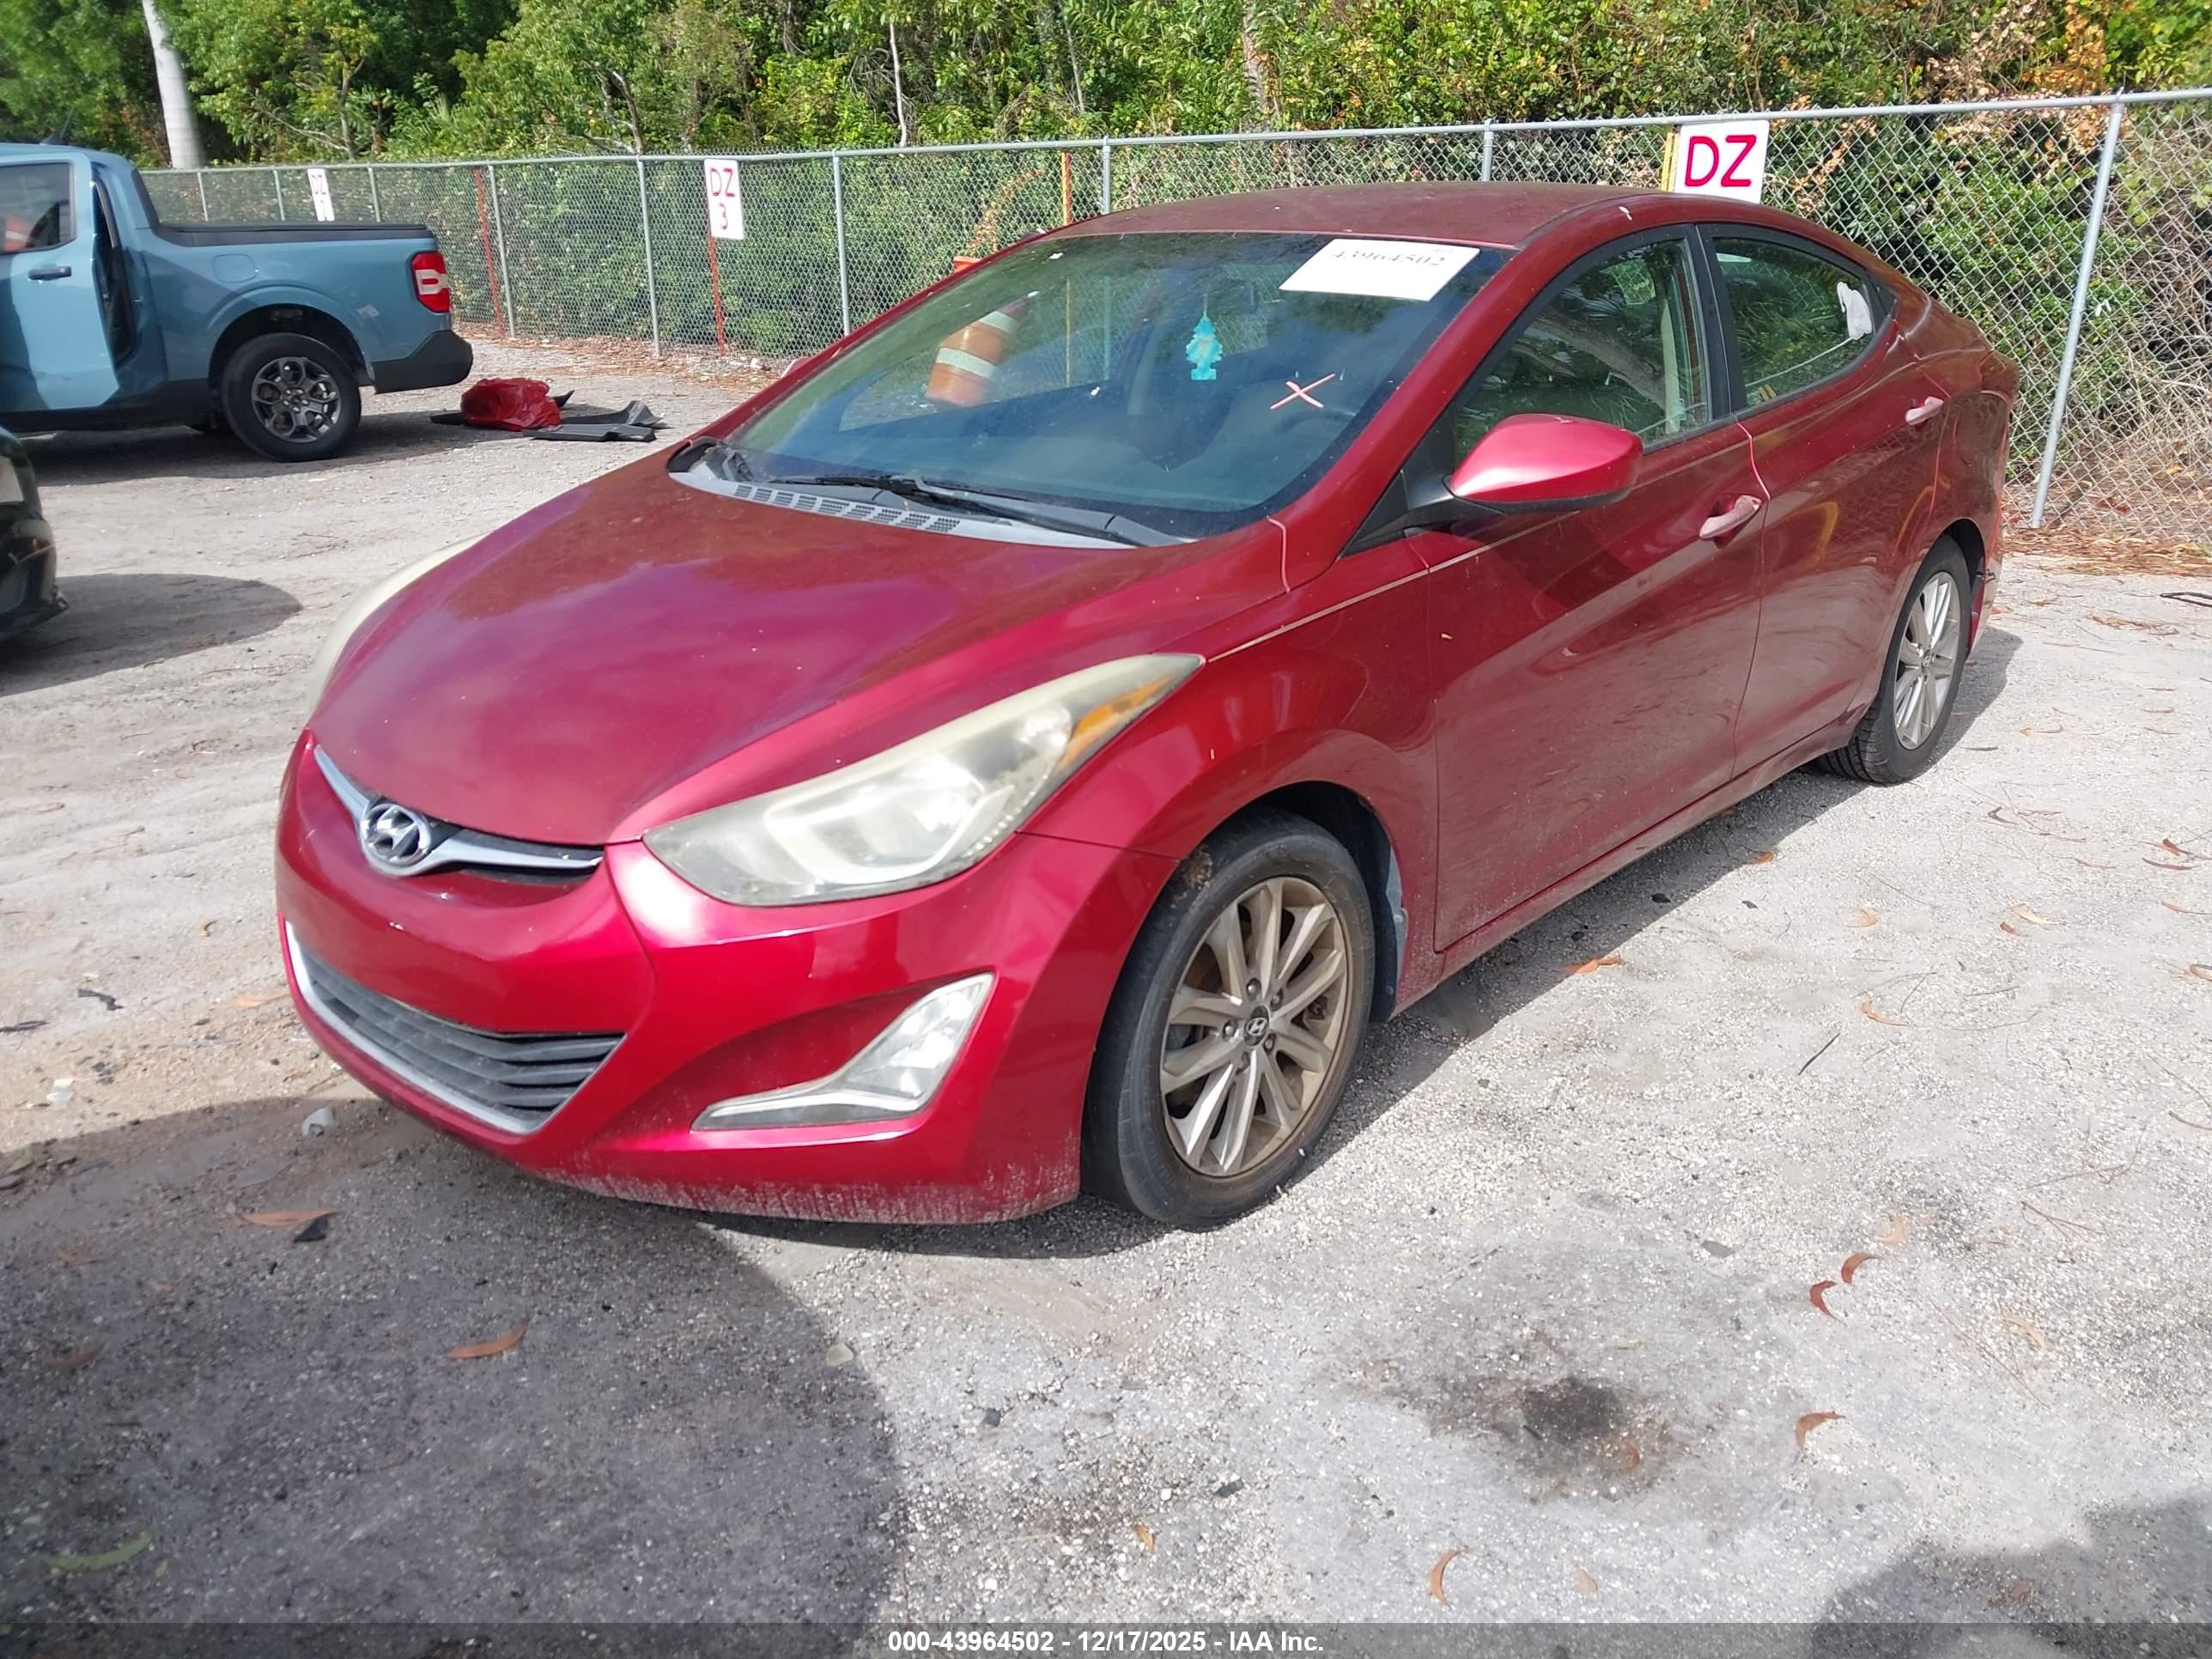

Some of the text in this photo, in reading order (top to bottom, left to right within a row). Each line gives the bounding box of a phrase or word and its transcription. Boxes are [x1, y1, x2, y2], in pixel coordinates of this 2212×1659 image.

[1685, 135, 1757, 187] DZ
[710, 167, 735, 197] DZ
[719, 202, 728, 230] 3
